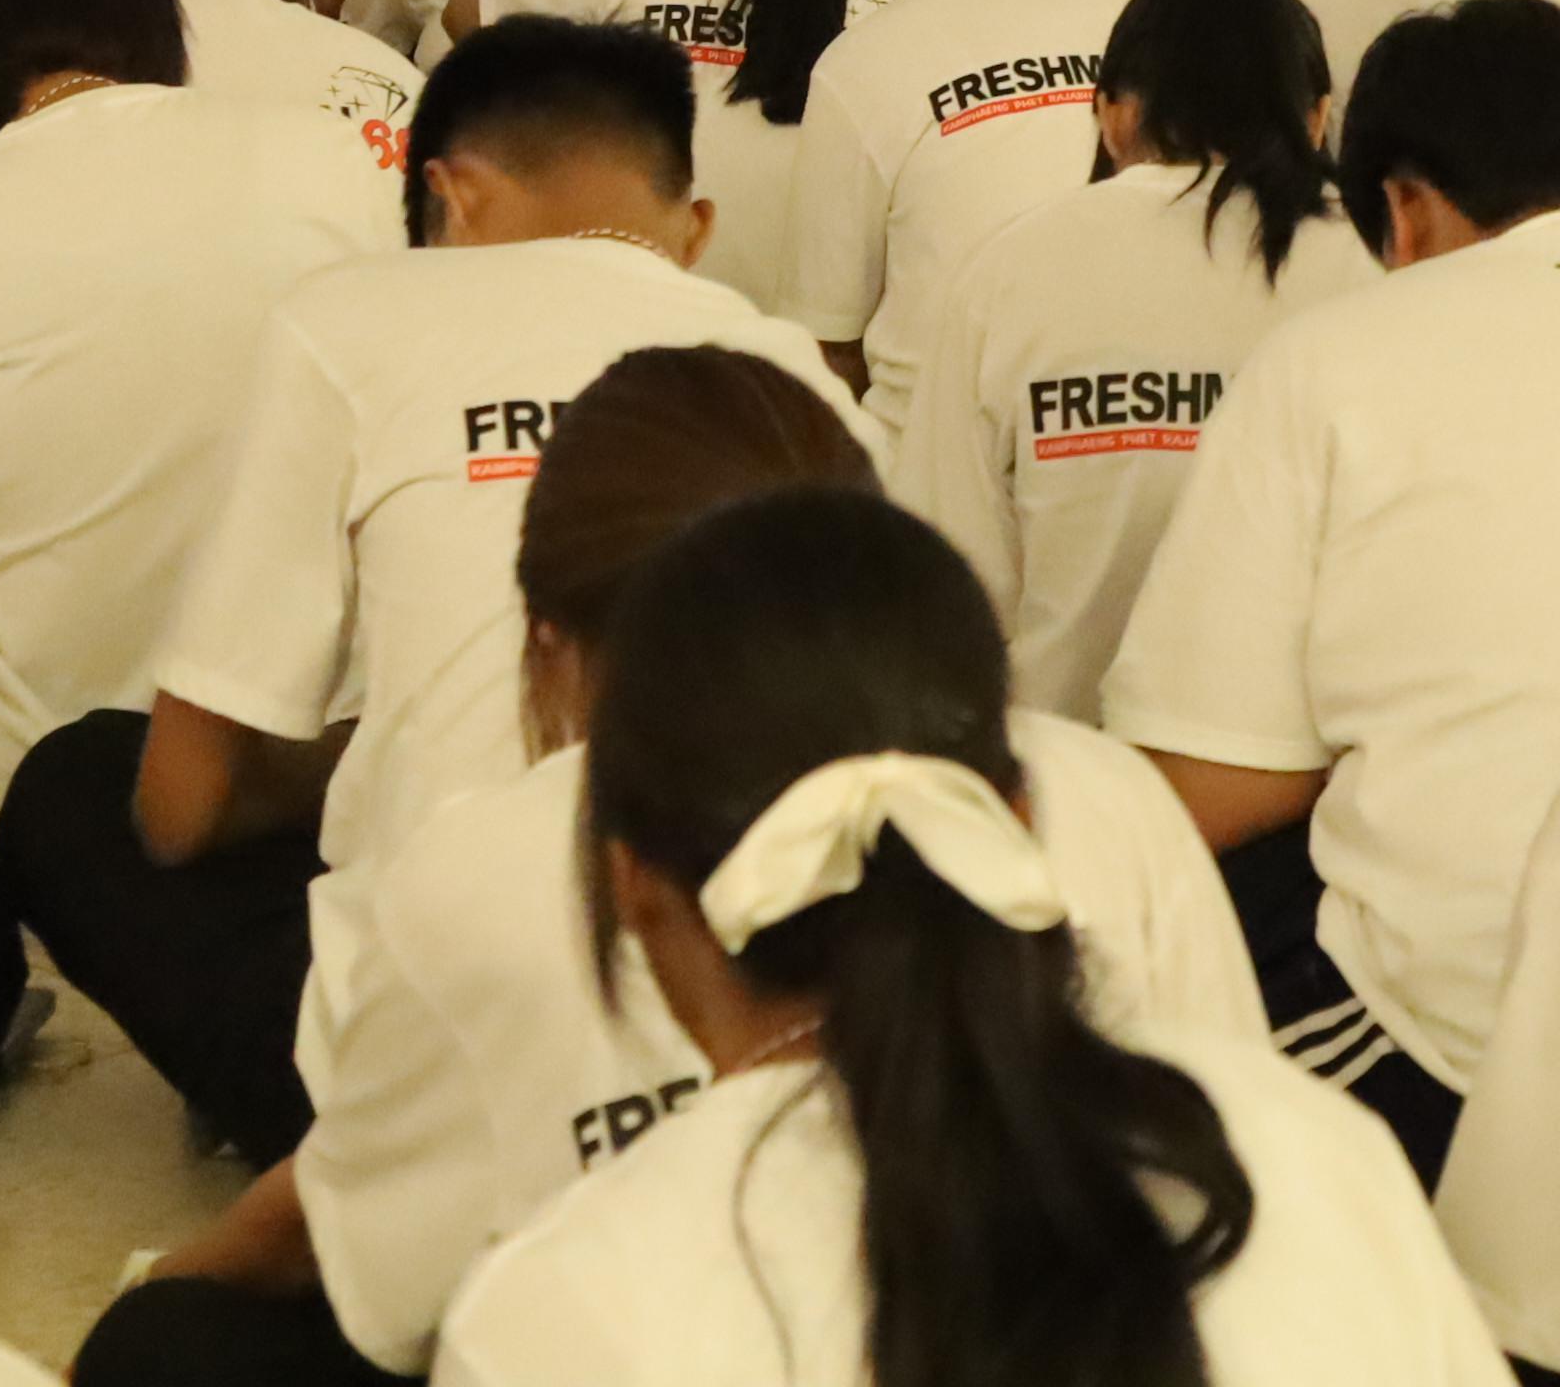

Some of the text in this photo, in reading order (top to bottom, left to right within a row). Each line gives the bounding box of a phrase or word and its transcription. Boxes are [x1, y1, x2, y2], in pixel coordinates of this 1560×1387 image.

[641, 4, 747, 47] FRES
[928, 55, 1102, 123] FRESHM
[1162, 433, 1198, 445] RAJA
